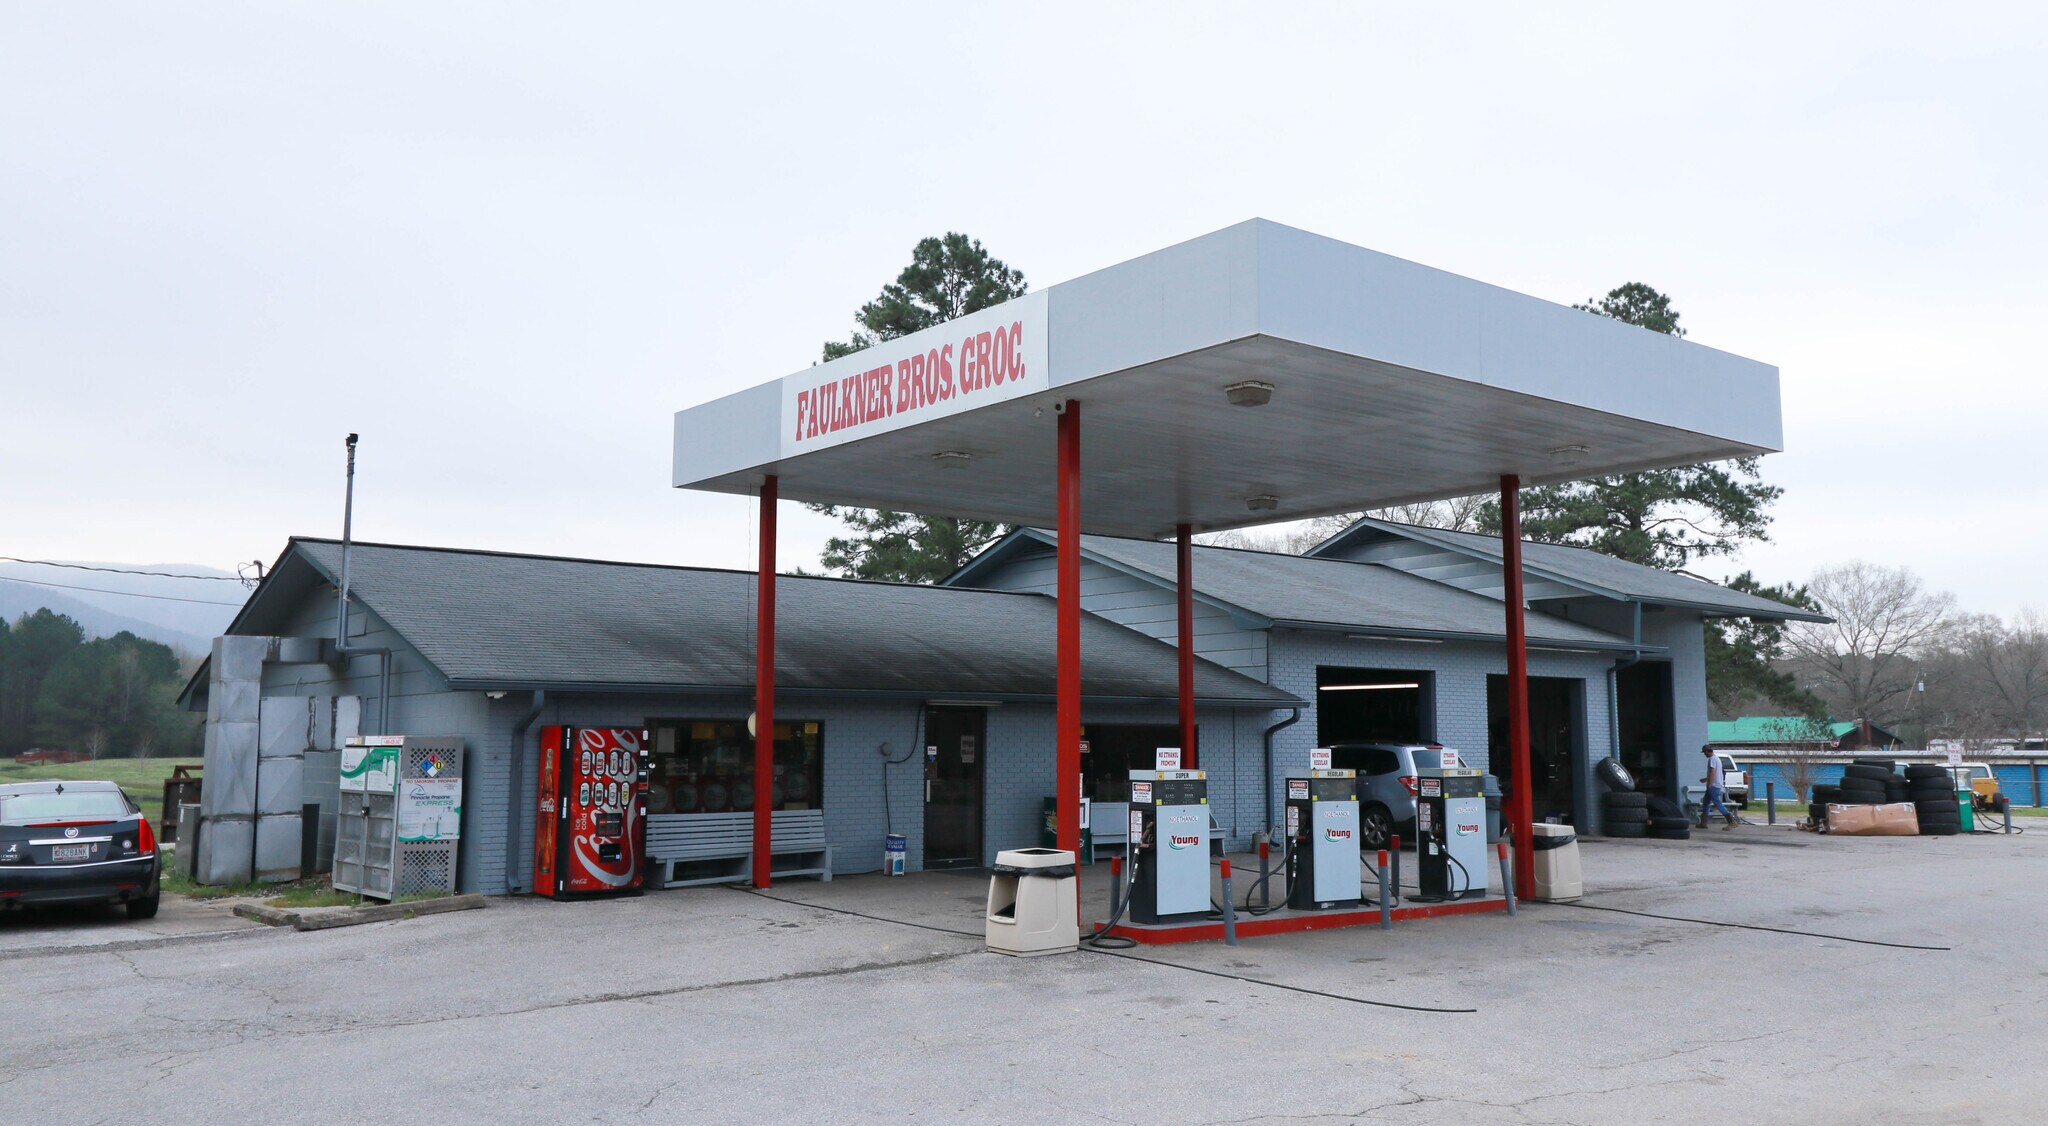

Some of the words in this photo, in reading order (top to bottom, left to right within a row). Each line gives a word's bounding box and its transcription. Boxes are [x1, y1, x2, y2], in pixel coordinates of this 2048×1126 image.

[795, 364, 893, 441] FAULKNER
[896, 343, 957, 413] BROS.
[959, 321, 1026, 395] GROC.
[430, 755, 435, 763] 4
[436, 761, 441, 769] 0
[1457, 824, 1479, 832] Young
[1326, 828, 1351, 838] Young
[1171, 835, 1199, 845] Young
